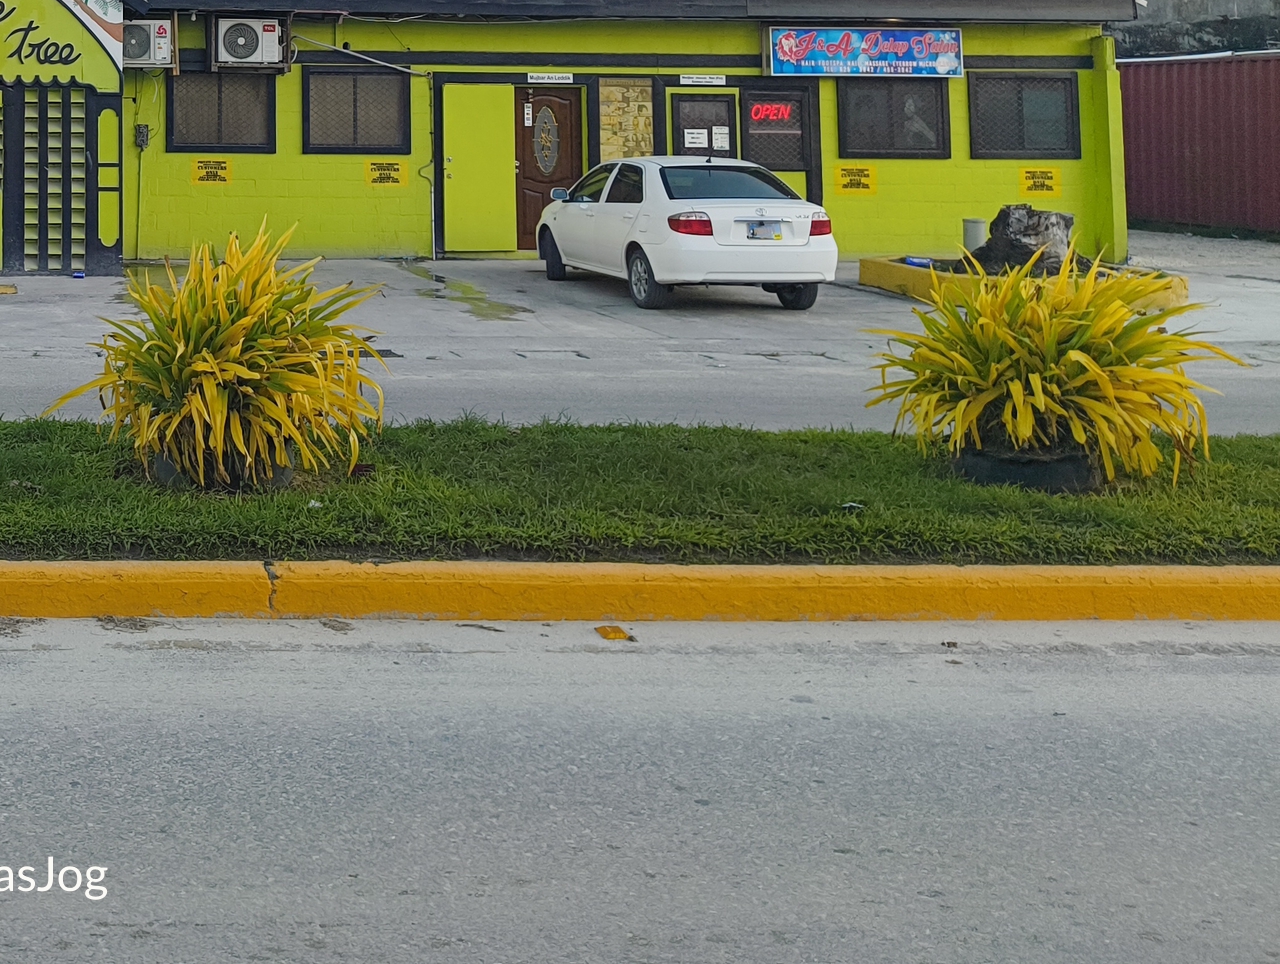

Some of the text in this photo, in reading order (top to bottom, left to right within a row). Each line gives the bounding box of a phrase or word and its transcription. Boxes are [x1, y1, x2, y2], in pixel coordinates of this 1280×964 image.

[816, 38, 826, 51] &
[825, 32, 855, 58] A
[910, 32, 959, 59] Salon
[751, 104, 791, 120] OPEN
